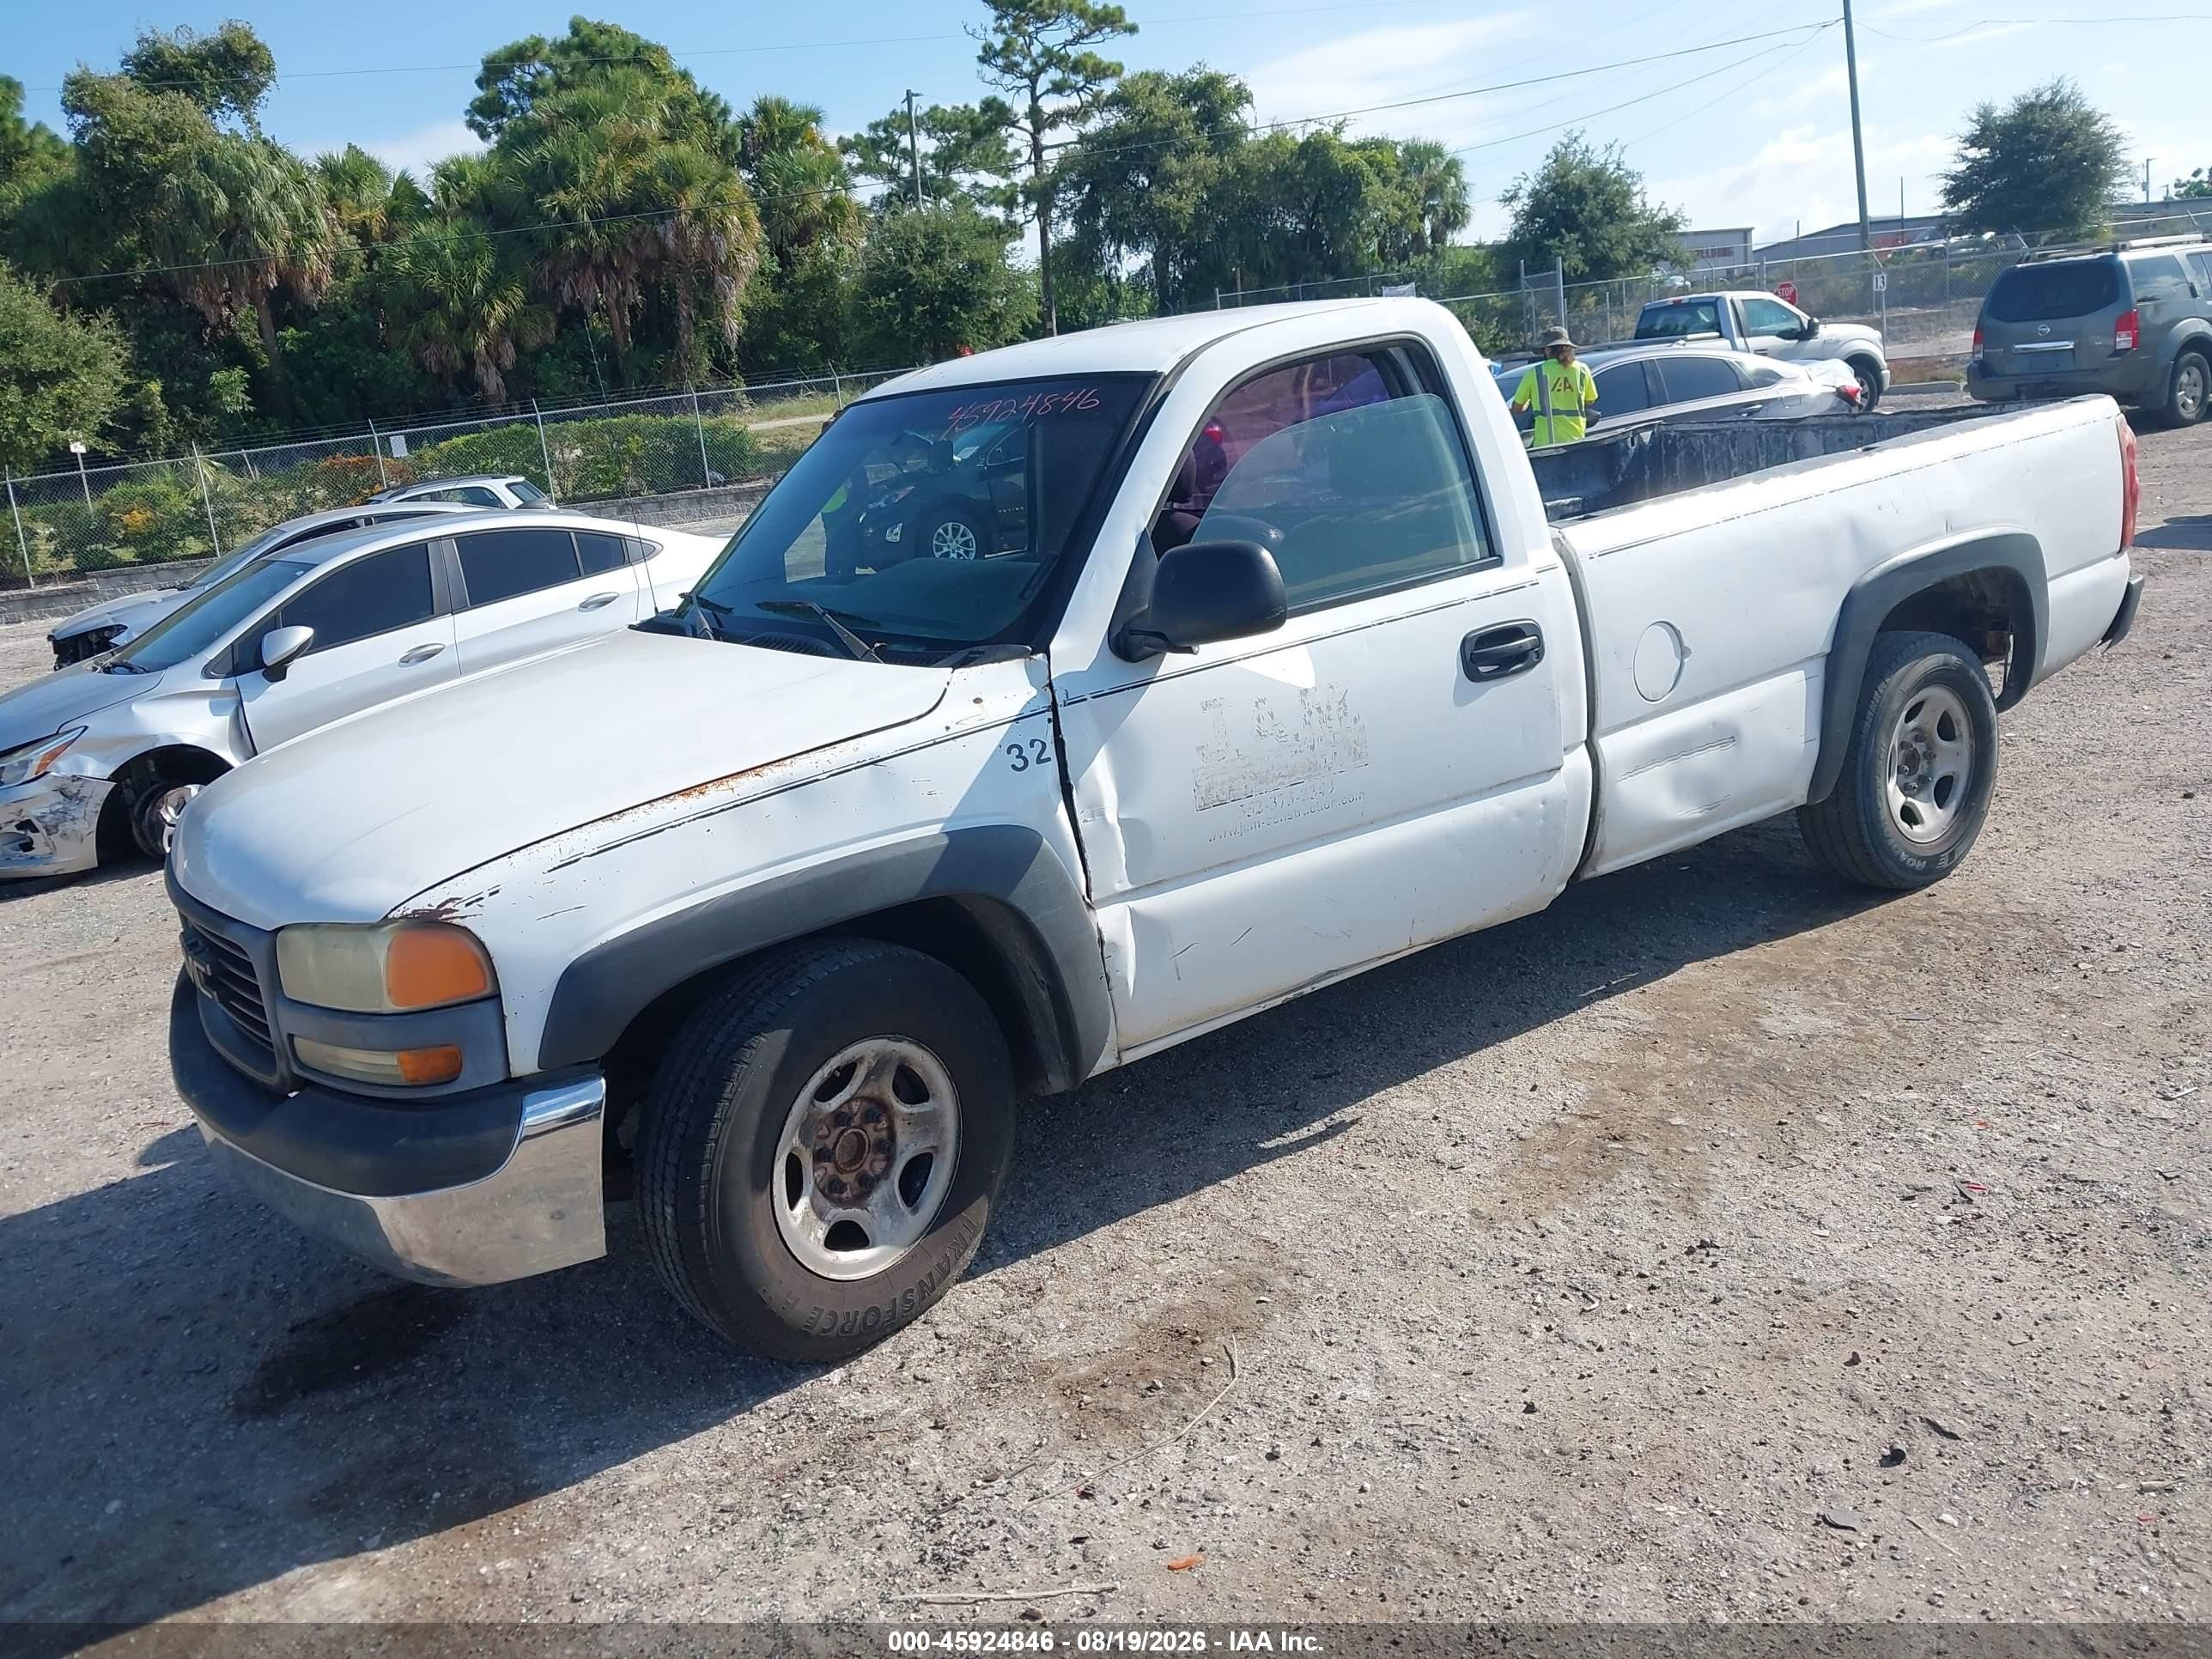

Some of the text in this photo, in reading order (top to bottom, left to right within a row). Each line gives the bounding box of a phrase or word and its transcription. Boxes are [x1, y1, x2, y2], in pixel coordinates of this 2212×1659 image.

[1778, 287, 1795, 298] STOP
[1875, 276, 1886, 289] 13
[939, 388, 1101, 441] 45924846
[1006, 738, 1052, 772] 32
